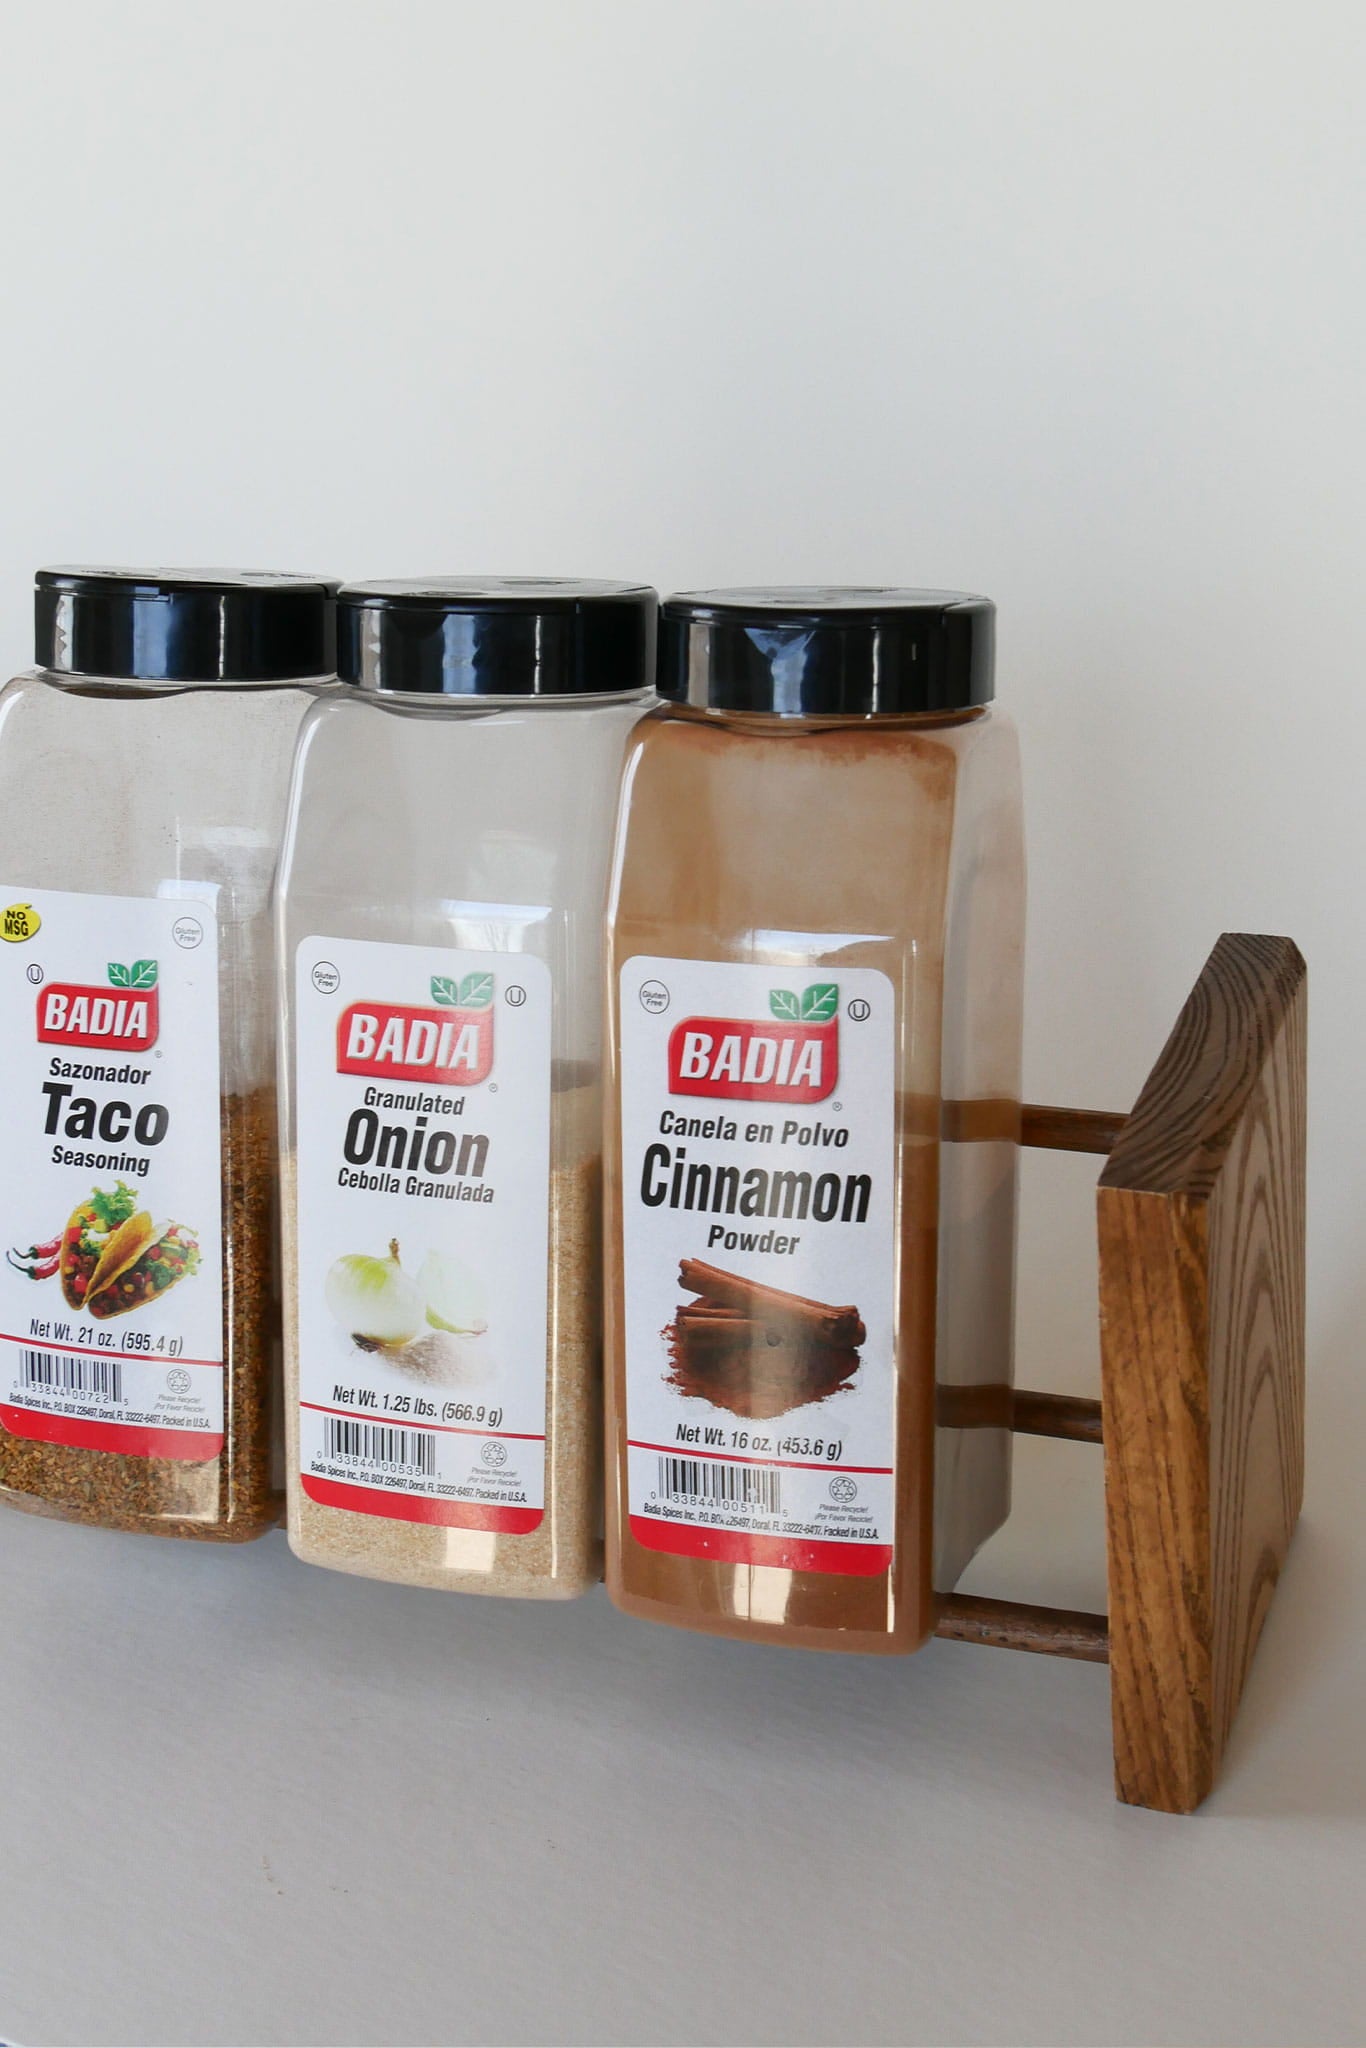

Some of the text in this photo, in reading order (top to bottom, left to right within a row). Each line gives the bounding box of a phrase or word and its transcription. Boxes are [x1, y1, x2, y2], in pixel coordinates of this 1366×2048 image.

[4, 919, 28, 937] MSG
[6, 910, 26, 920] NO
[44, 993, 148, 1039] BADIA
[346, 1013, 480, 1070] BADIA
[679, 1031, 823, 1088] BADIA
[49, 1057, 151, 1085] Sazonador
[41, 1081, 170, 1146] Taco
[364, 1087, 465, 1115] Granulated
[343, 1108, 490, 1177] Onion
[659, 1111, 849, 1148] Canela en Polvo
[51, 1145, 150, 1177] Seasoning
[338, 1167, 494, 1203] Cebolla Granulada
[640, 1143, 872, 1223] Cinnamon
[707, 1225, 801, 1255] Powder
[30, 1318, 183, 1357] Net Wt. 21 oz. (595.4 g)
[31, 1383, 65, 1396] 33844
[72, 1390, 109, 1404] 00722
[333, 1385, 503, 1427] Net Wt. 1.25 lbs. (566.9 g)
[676, 1424, 842, 1462] Net Wt. 16 oz. (453.6 g)
[336, 1453, 374, 1468] 33844
[382, 1462, 421, 1477] 00535
[672, 1493, 714, 1508] 33844
[722, 1500, 764, 1514] 00511
